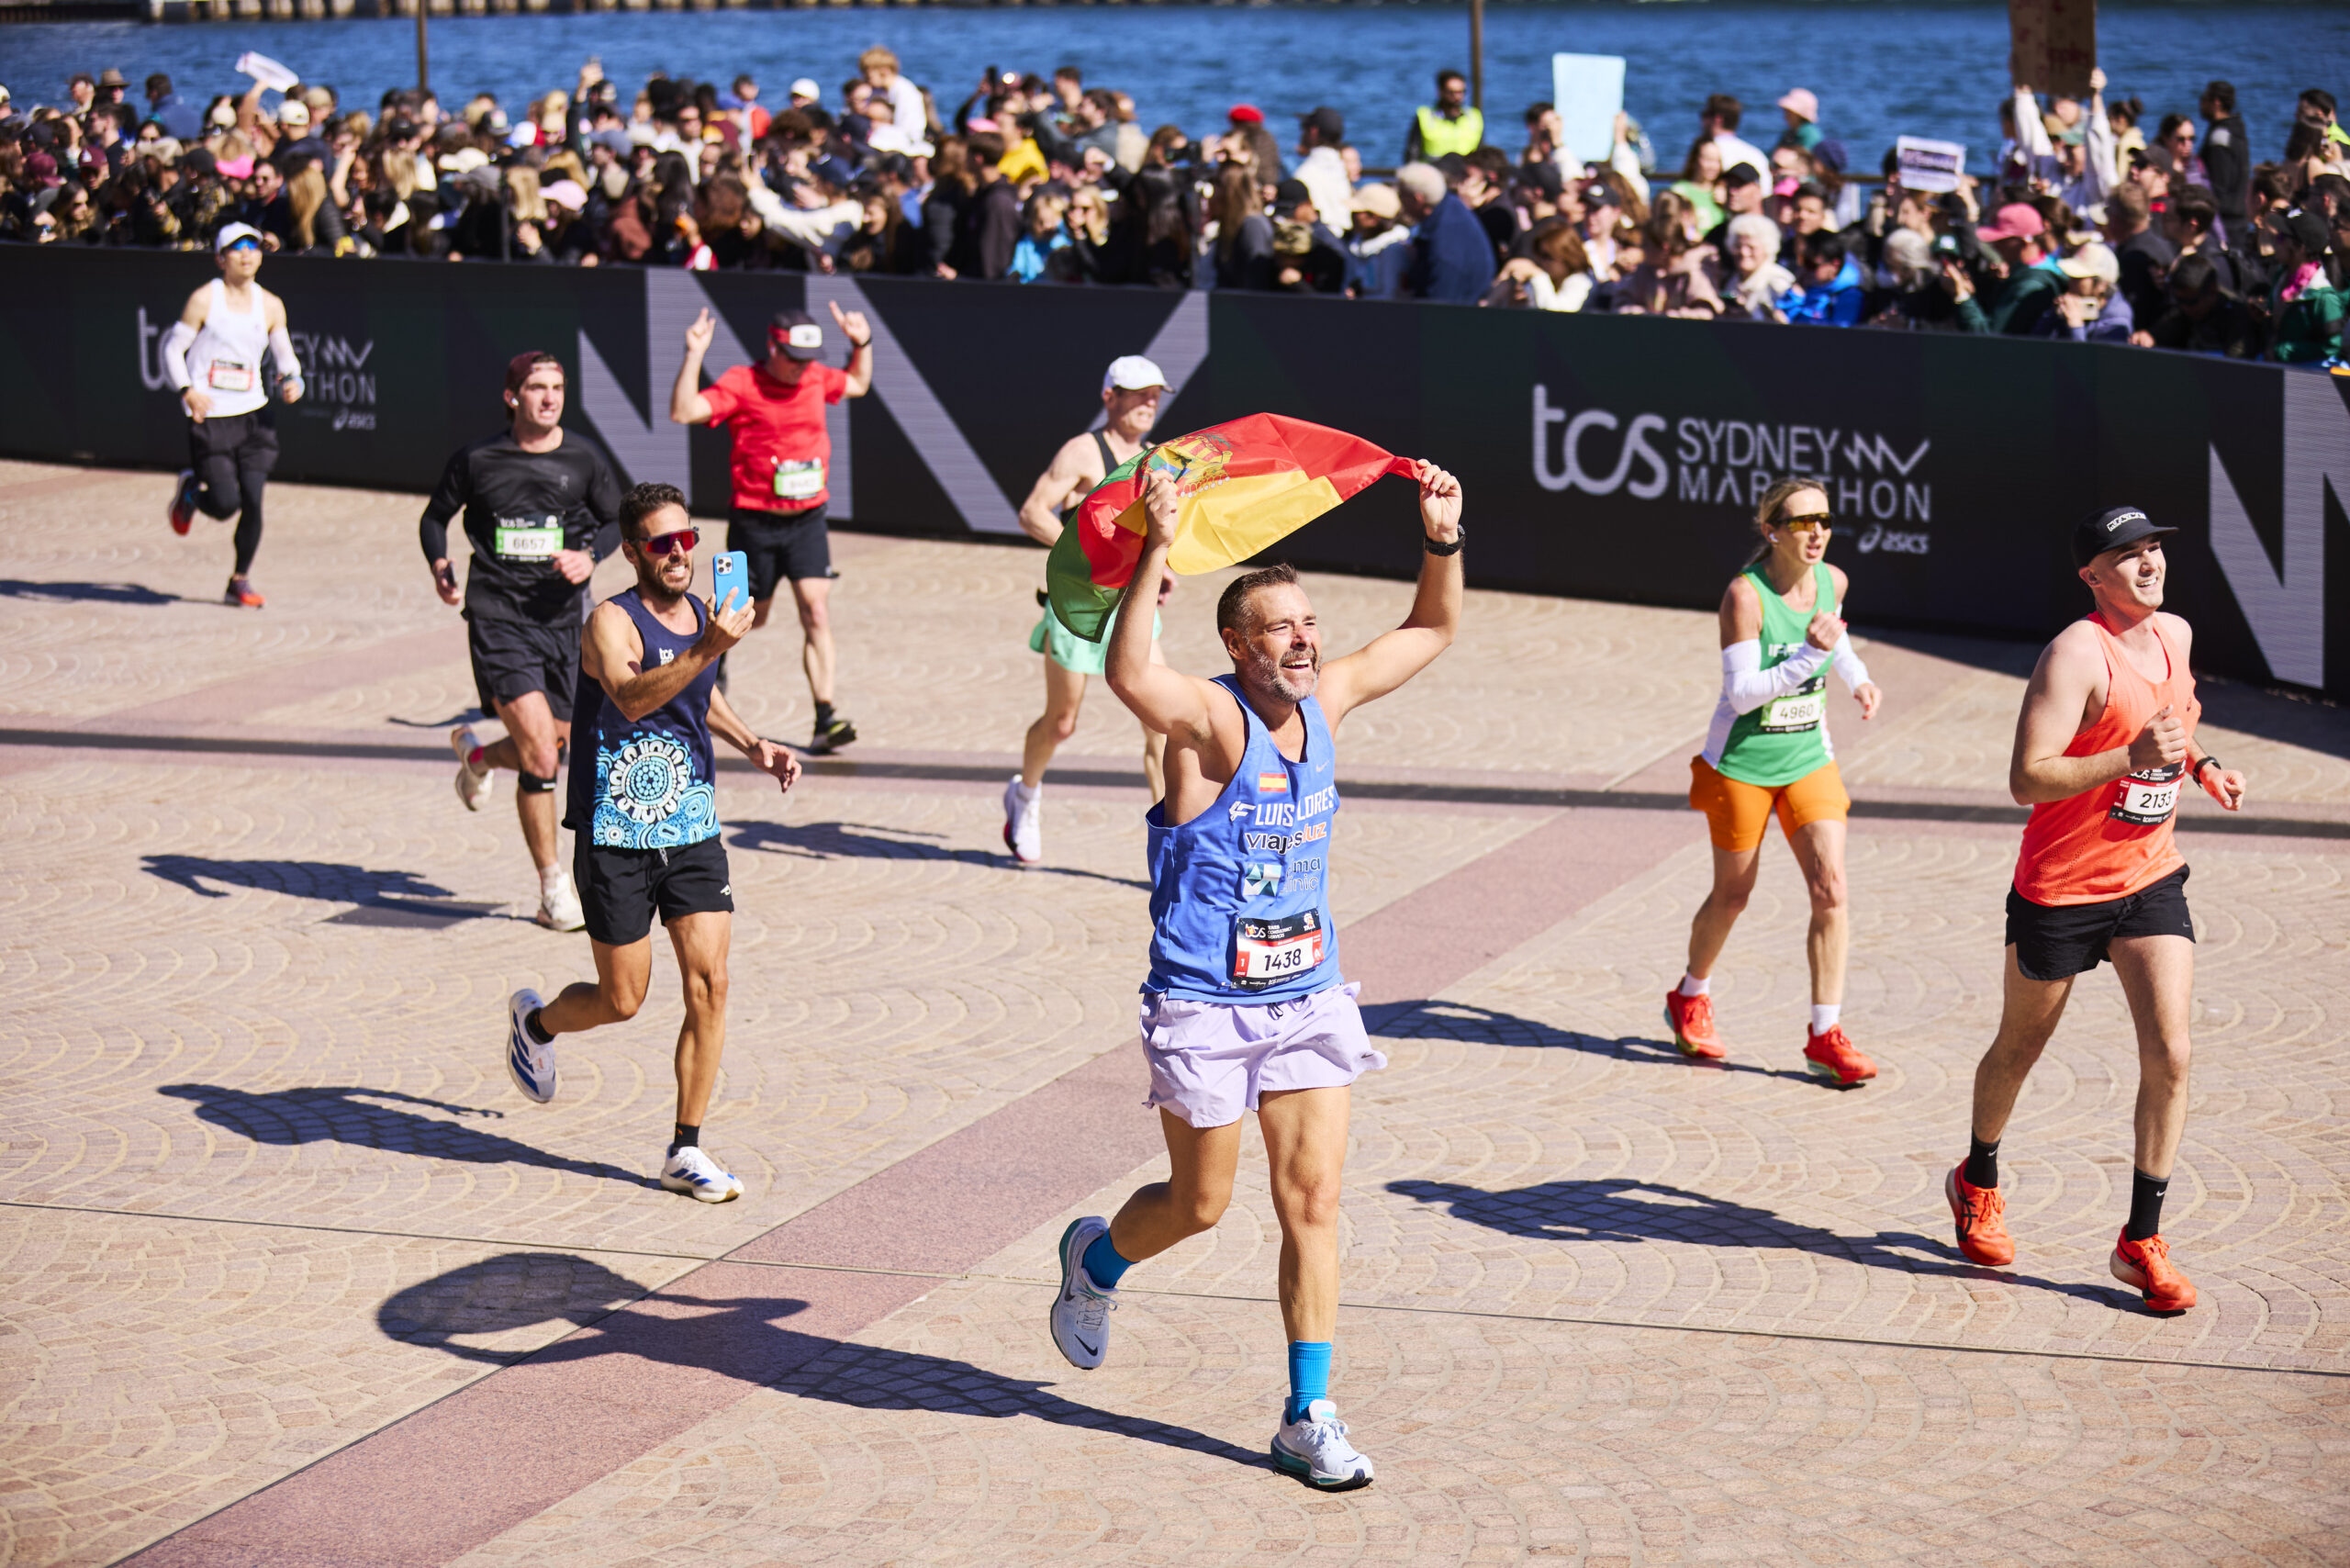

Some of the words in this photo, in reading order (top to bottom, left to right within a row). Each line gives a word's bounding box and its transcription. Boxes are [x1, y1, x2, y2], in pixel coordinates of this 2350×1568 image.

[1532, 384, 1670, 499] tcs
[1677, 418, 1840, 473] SYDNEY
[1678, 465, 1931, 521] MARHON
[513, 537, 546, 550] 6657
[1779, 704, 1814, 720] 4960
[1255, 802, 1295, 827] LUIS
[1264, 947, 1302, 971] 1438
